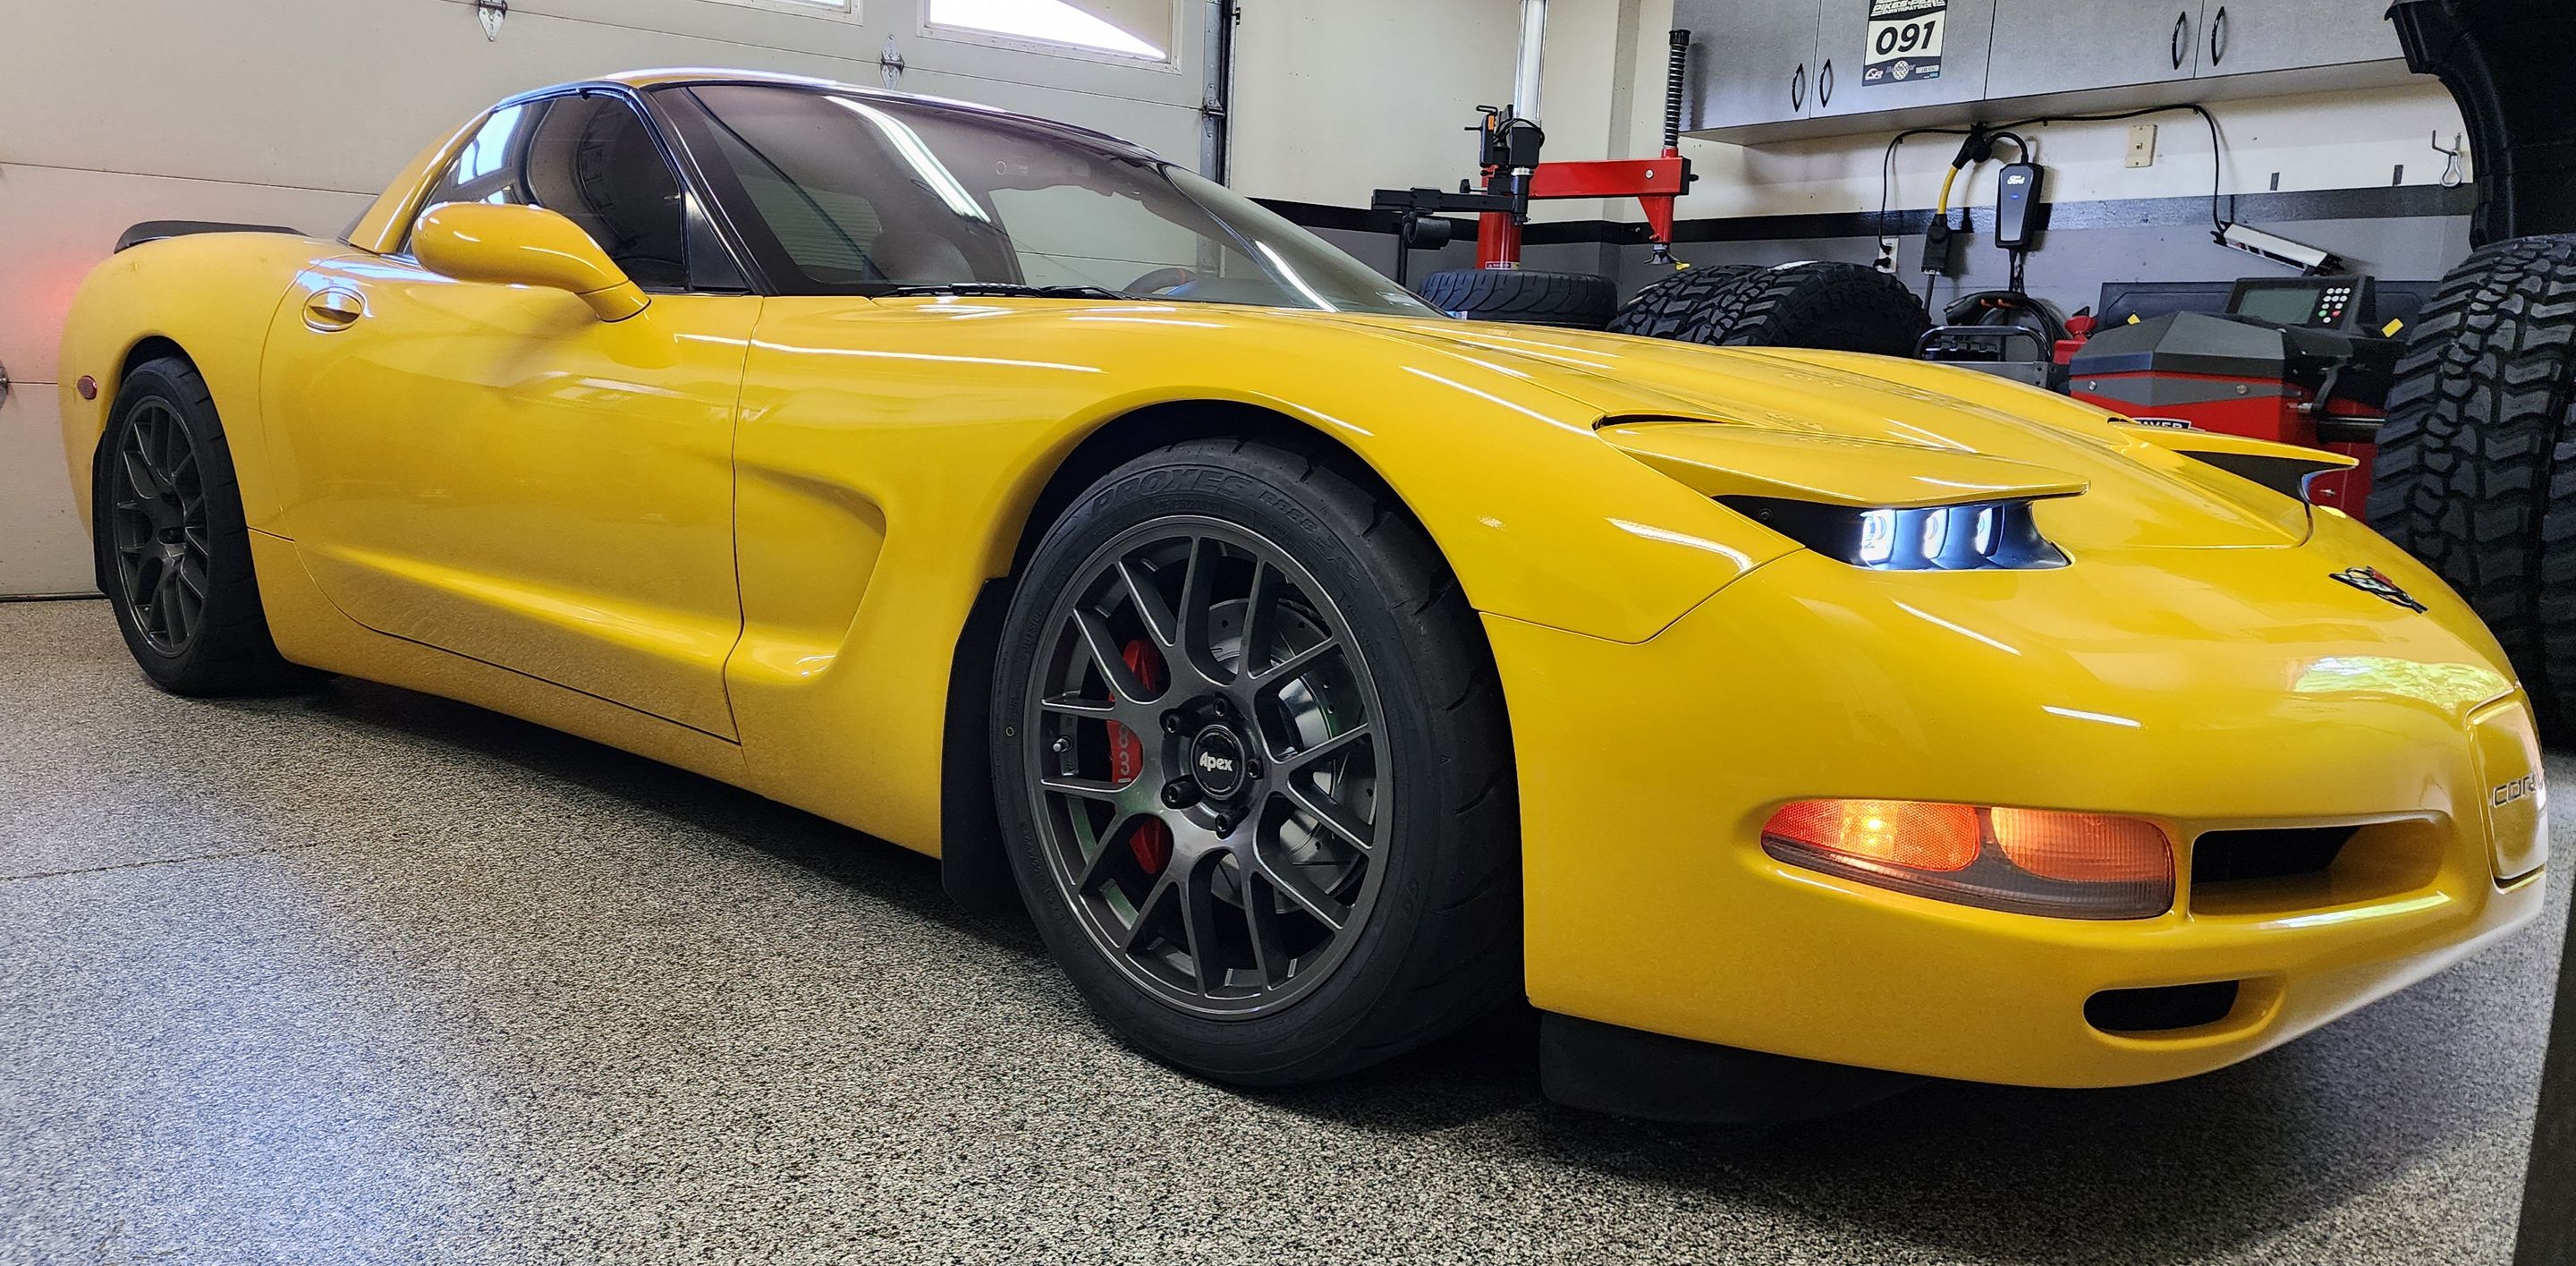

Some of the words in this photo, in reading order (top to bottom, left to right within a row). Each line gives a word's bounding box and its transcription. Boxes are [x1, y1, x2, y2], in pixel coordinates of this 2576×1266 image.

[1876, 21, 1936, 55] 091
[2007, 175, 2025, 184] Ford
[1090, 468, 1253, 514] PROXES
